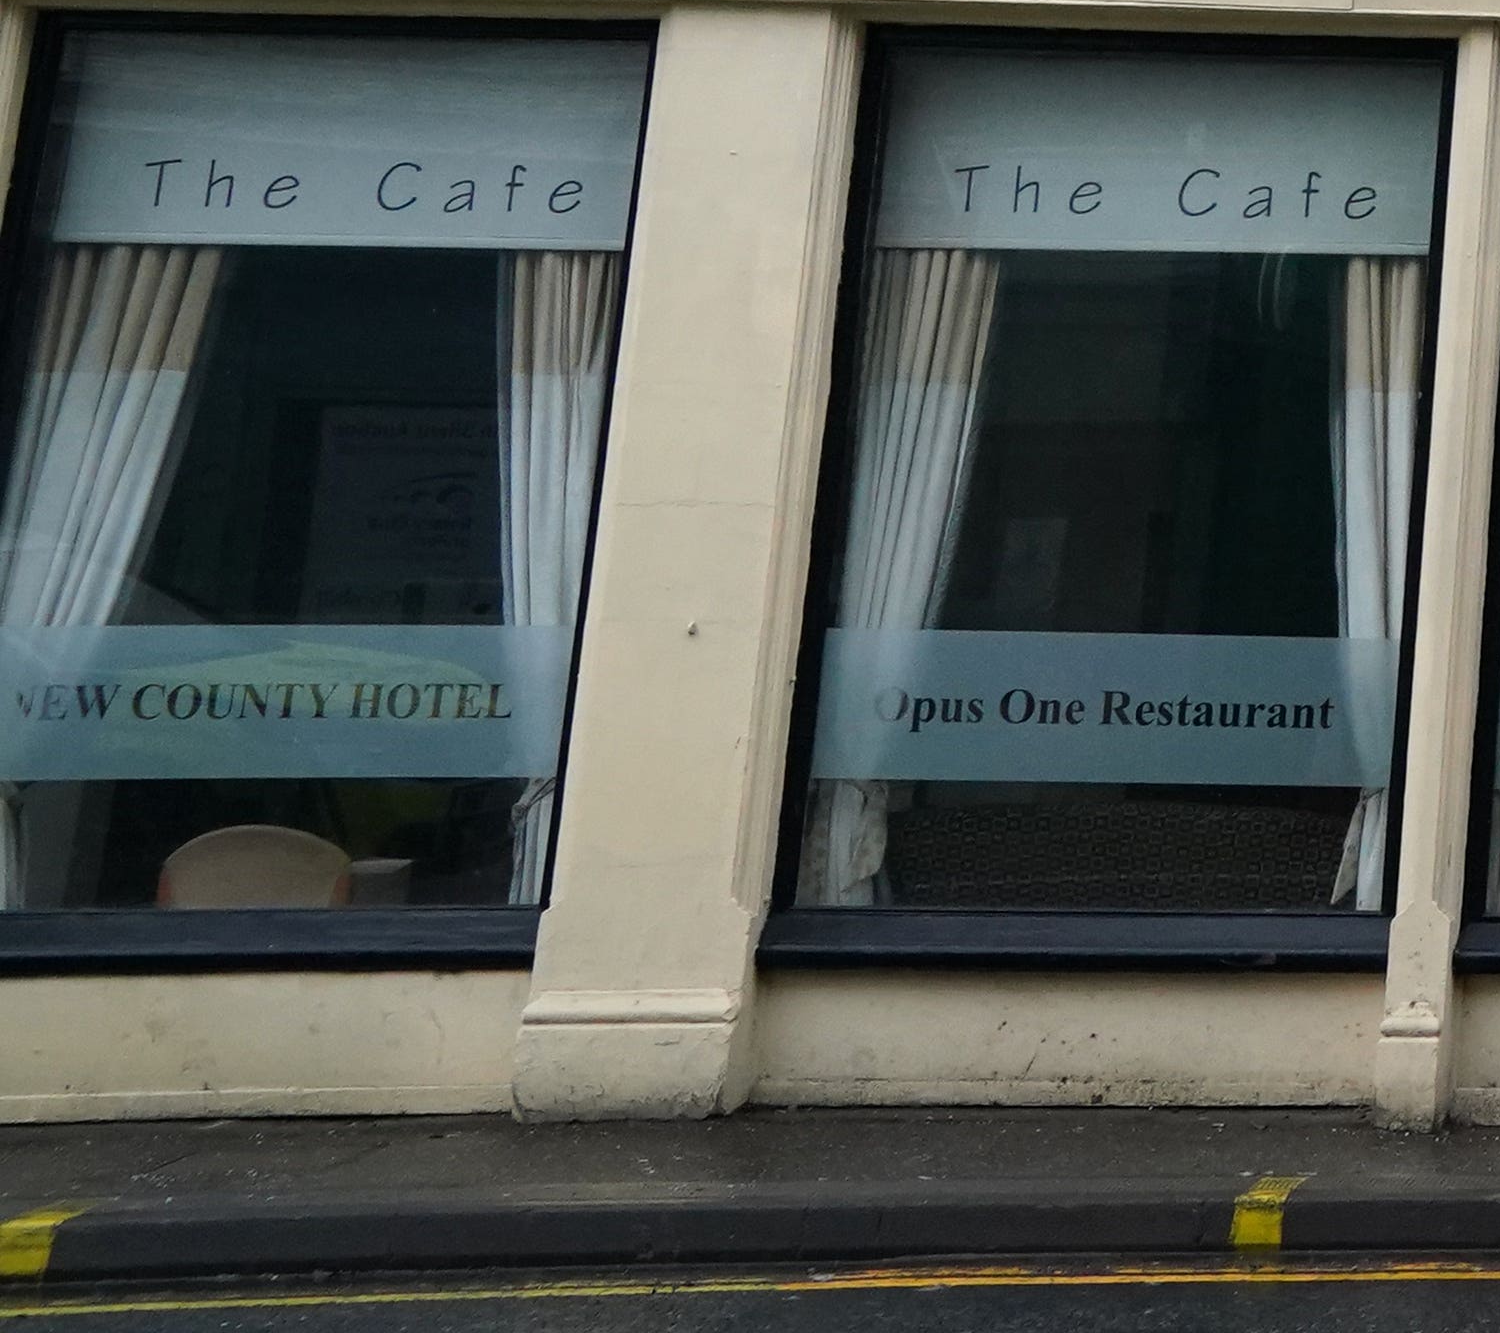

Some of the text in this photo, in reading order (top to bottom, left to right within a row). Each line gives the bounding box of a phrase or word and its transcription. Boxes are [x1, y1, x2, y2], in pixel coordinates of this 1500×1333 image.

[145, 158, 585, 215] The Cafe
[953, 165, 1378, 221] The Cafe
[132, 683, 338, 721] COUNTY
[348, 683, 514, 720] HOTEL
[875, 688, 1335, 734] Opus One Restaurant
